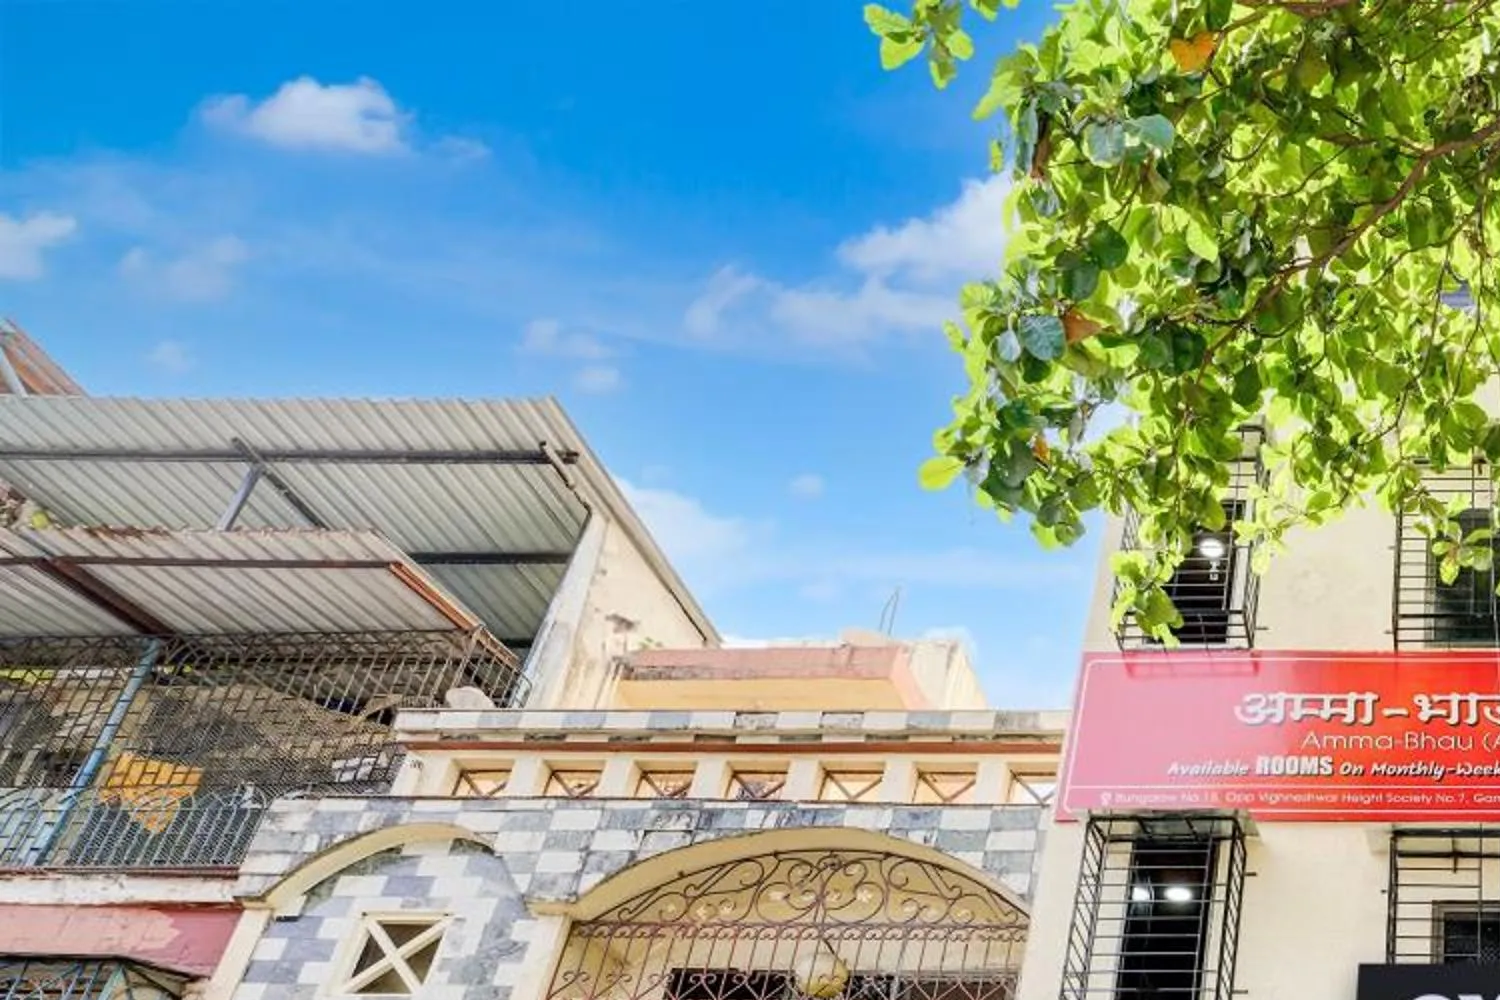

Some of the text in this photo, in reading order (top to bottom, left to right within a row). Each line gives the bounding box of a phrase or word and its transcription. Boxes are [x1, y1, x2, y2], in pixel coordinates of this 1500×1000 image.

[1167, 761, 1249, 775] Available
[1256, 755, 1333, 776] ROOMS
[1339, 763, 1365, 776] On
[1386, 792, 1433, 805] Society
